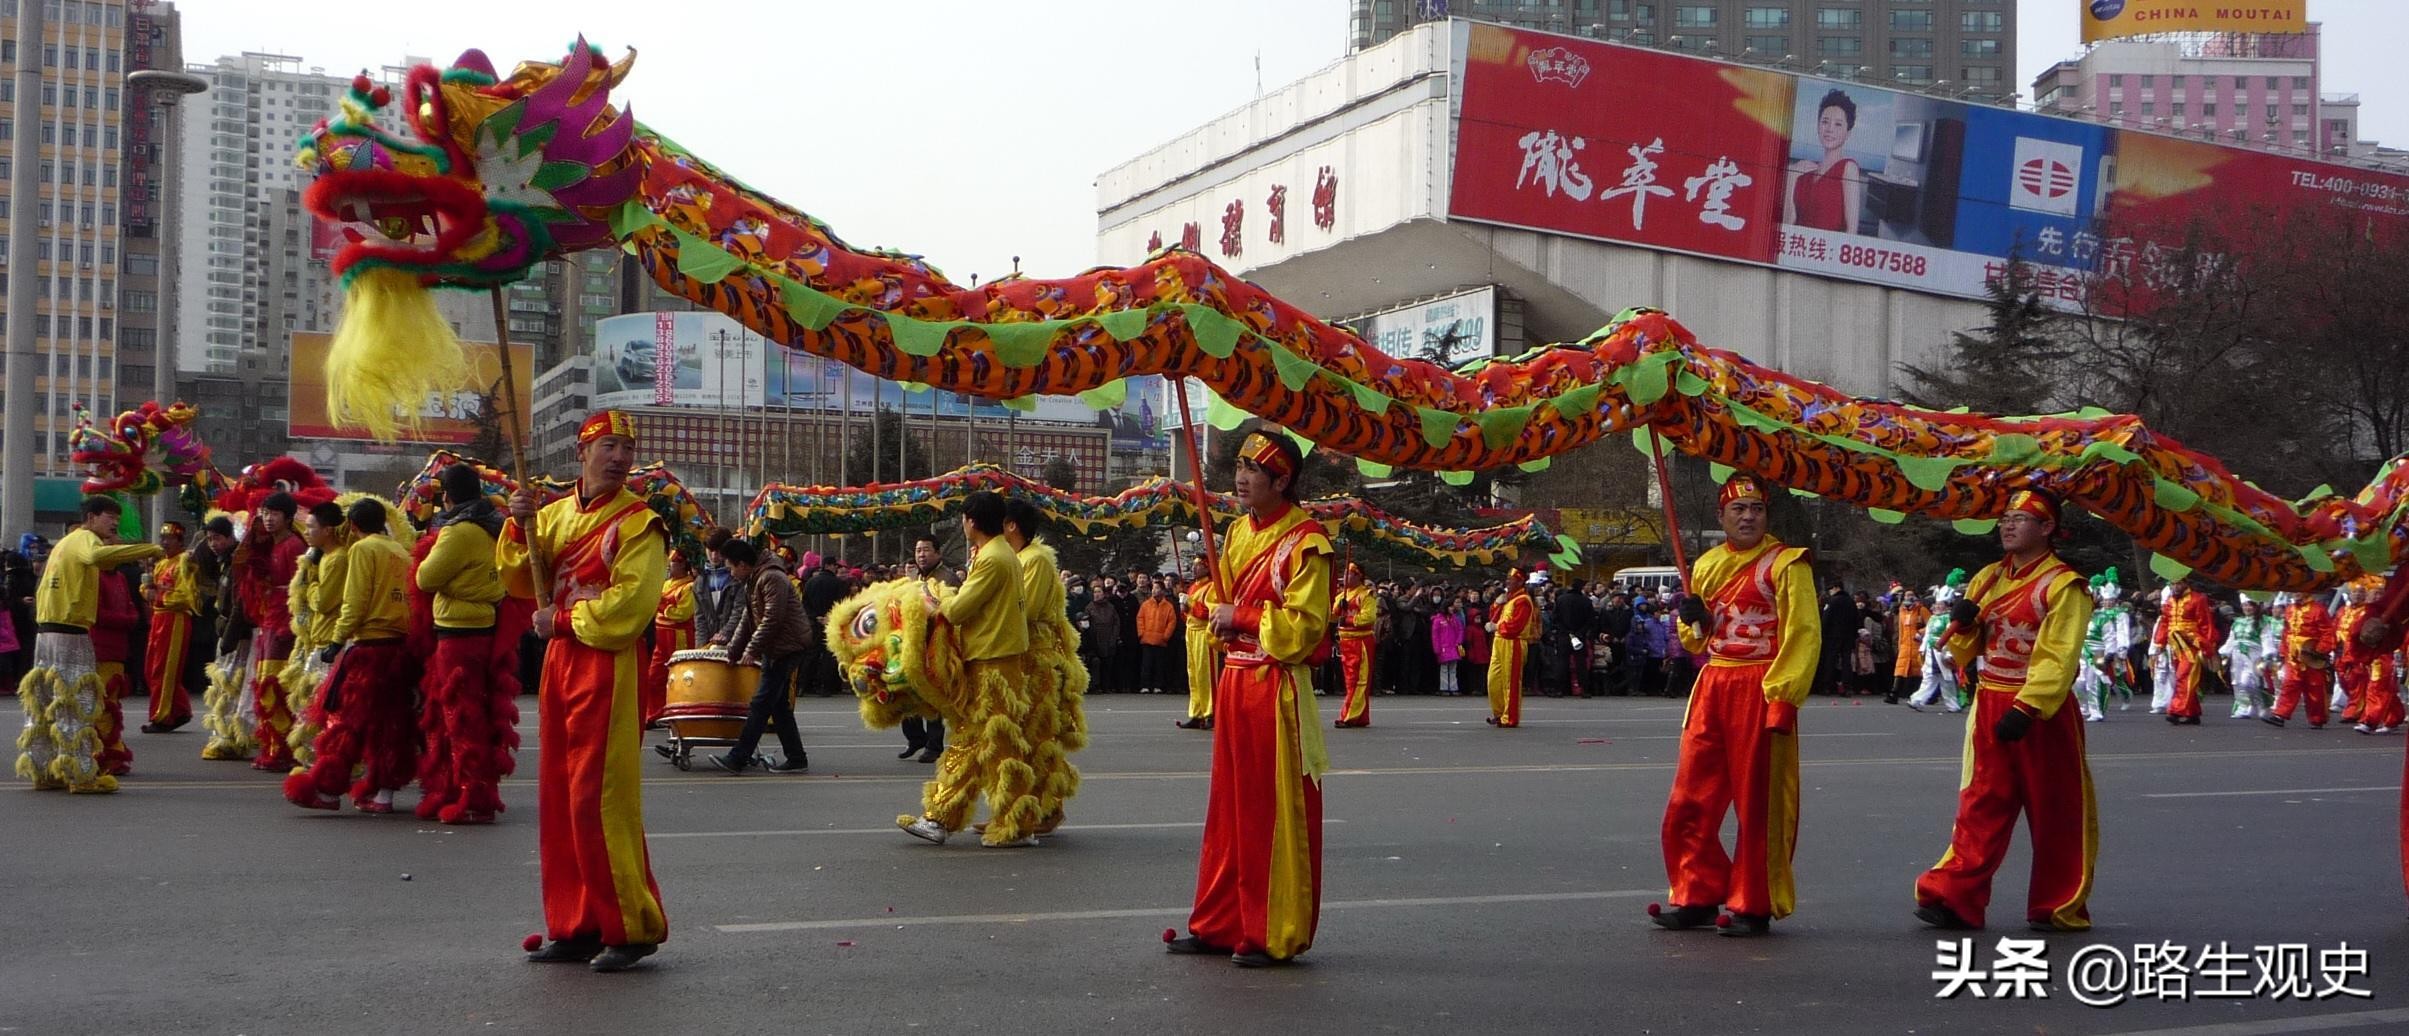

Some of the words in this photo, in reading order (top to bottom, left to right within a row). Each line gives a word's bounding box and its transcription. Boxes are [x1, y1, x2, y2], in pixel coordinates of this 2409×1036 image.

[2134, 8, 2199, 22] CHINA
[2216, 8, 2291, 21] MOUTAI
[1984, 261, 2079, 300] 甘信合
[1015, 445, 1084, 468] 金夫人
